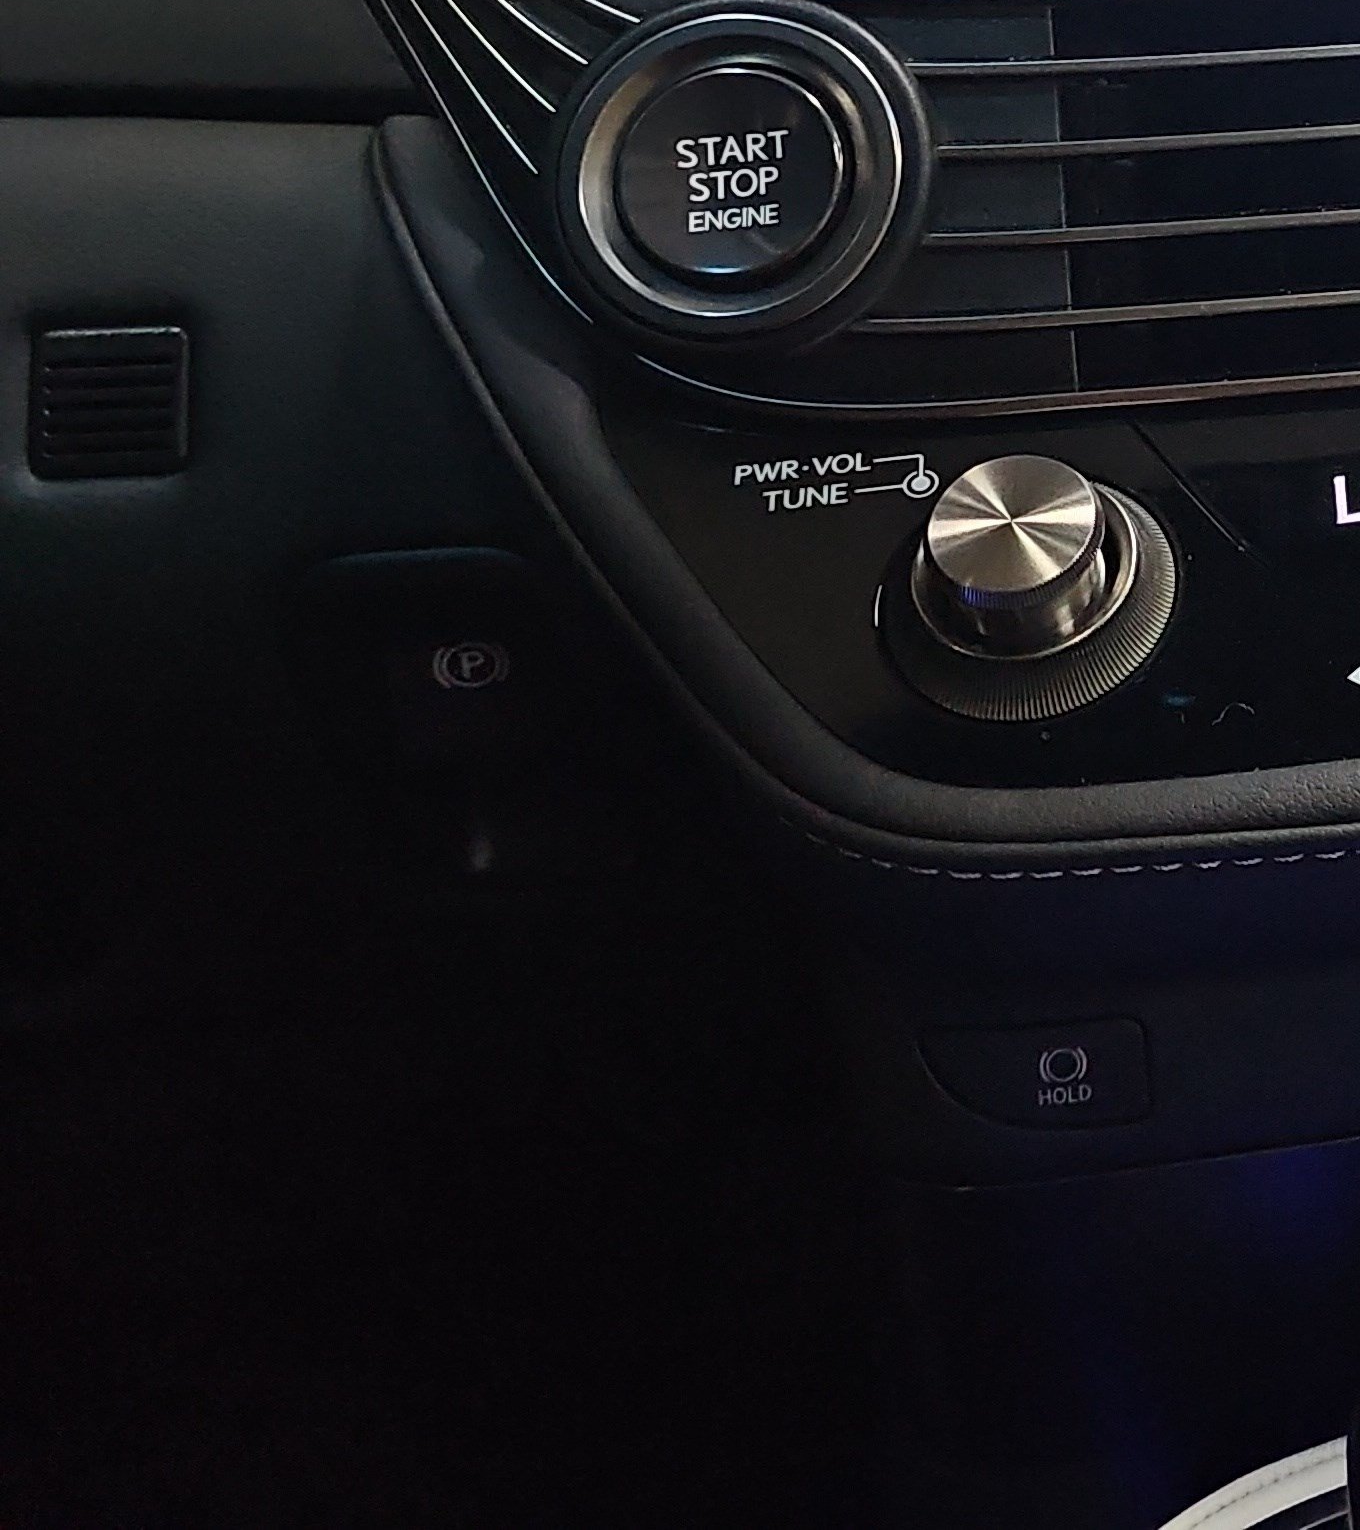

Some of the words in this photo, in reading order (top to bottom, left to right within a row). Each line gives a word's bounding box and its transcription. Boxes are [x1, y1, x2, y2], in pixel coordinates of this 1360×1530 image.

[675, 130, 789, 170] START
[688, 166, 779, 203] STOP
[688, 203, 780, 233] ENGINE
[763, 482, 849, 513] TUNE
[1038, 1084, 1092, 1106] HOLD
